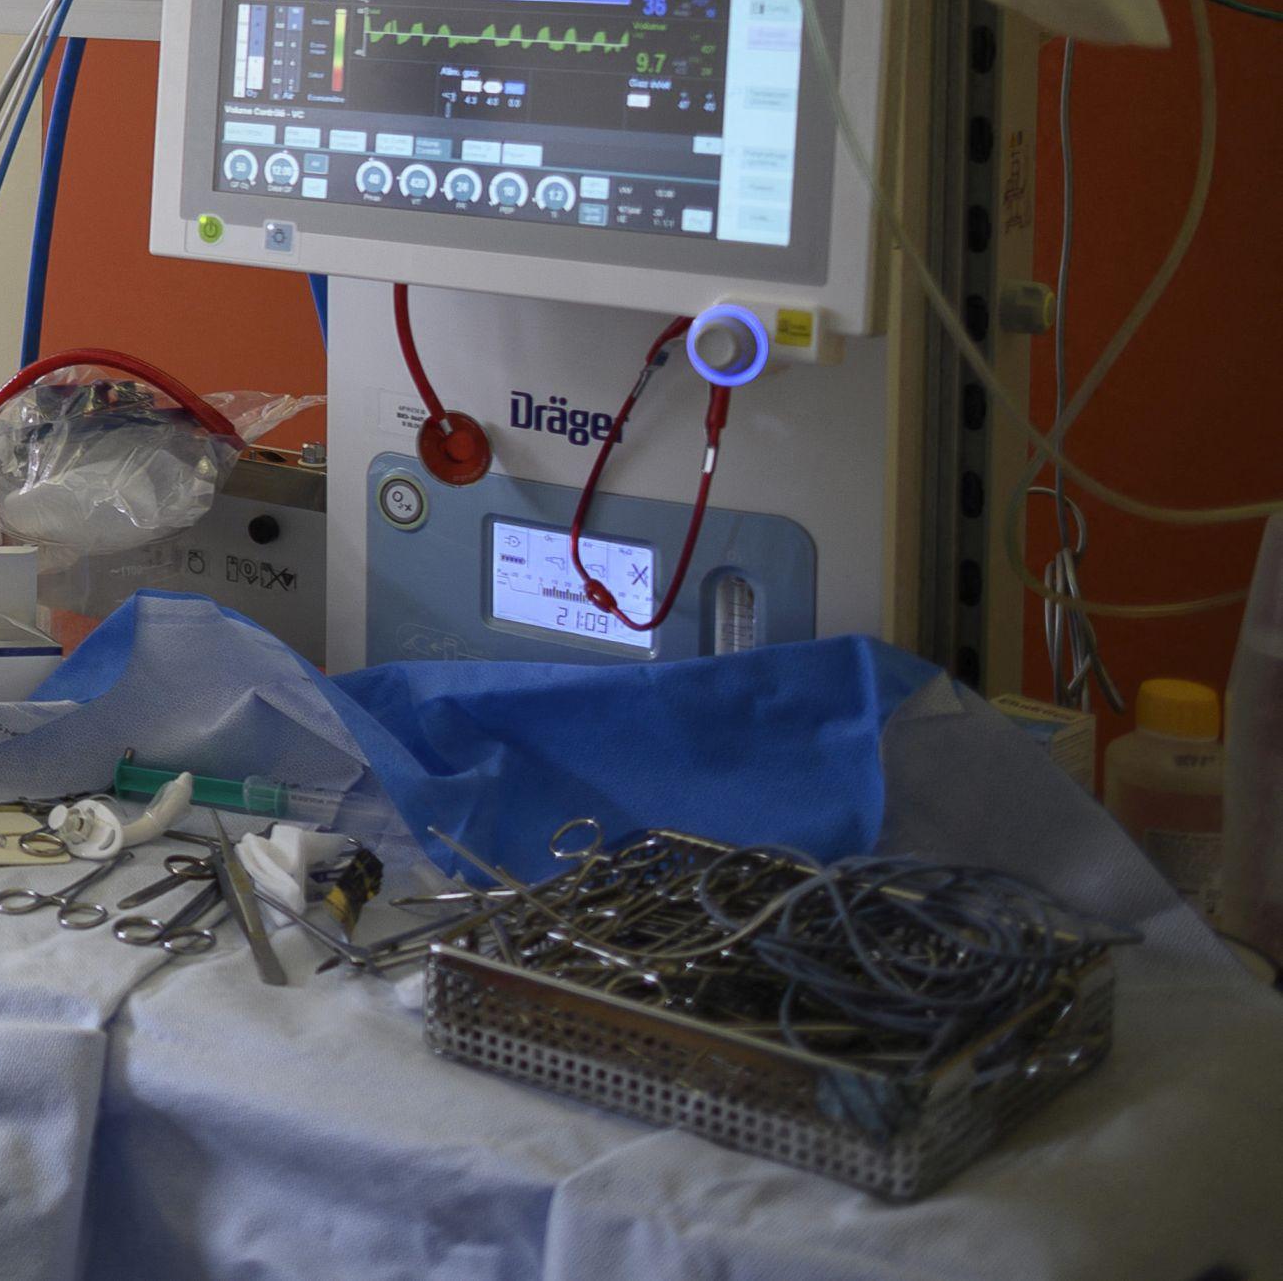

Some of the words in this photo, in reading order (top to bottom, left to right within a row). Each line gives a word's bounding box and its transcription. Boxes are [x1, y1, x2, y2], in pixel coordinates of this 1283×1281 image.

[636, 53, 666, 73] 9.7
[511, 390, 628, 446] Dräger
[556, 607, 608, 634] 21:09
